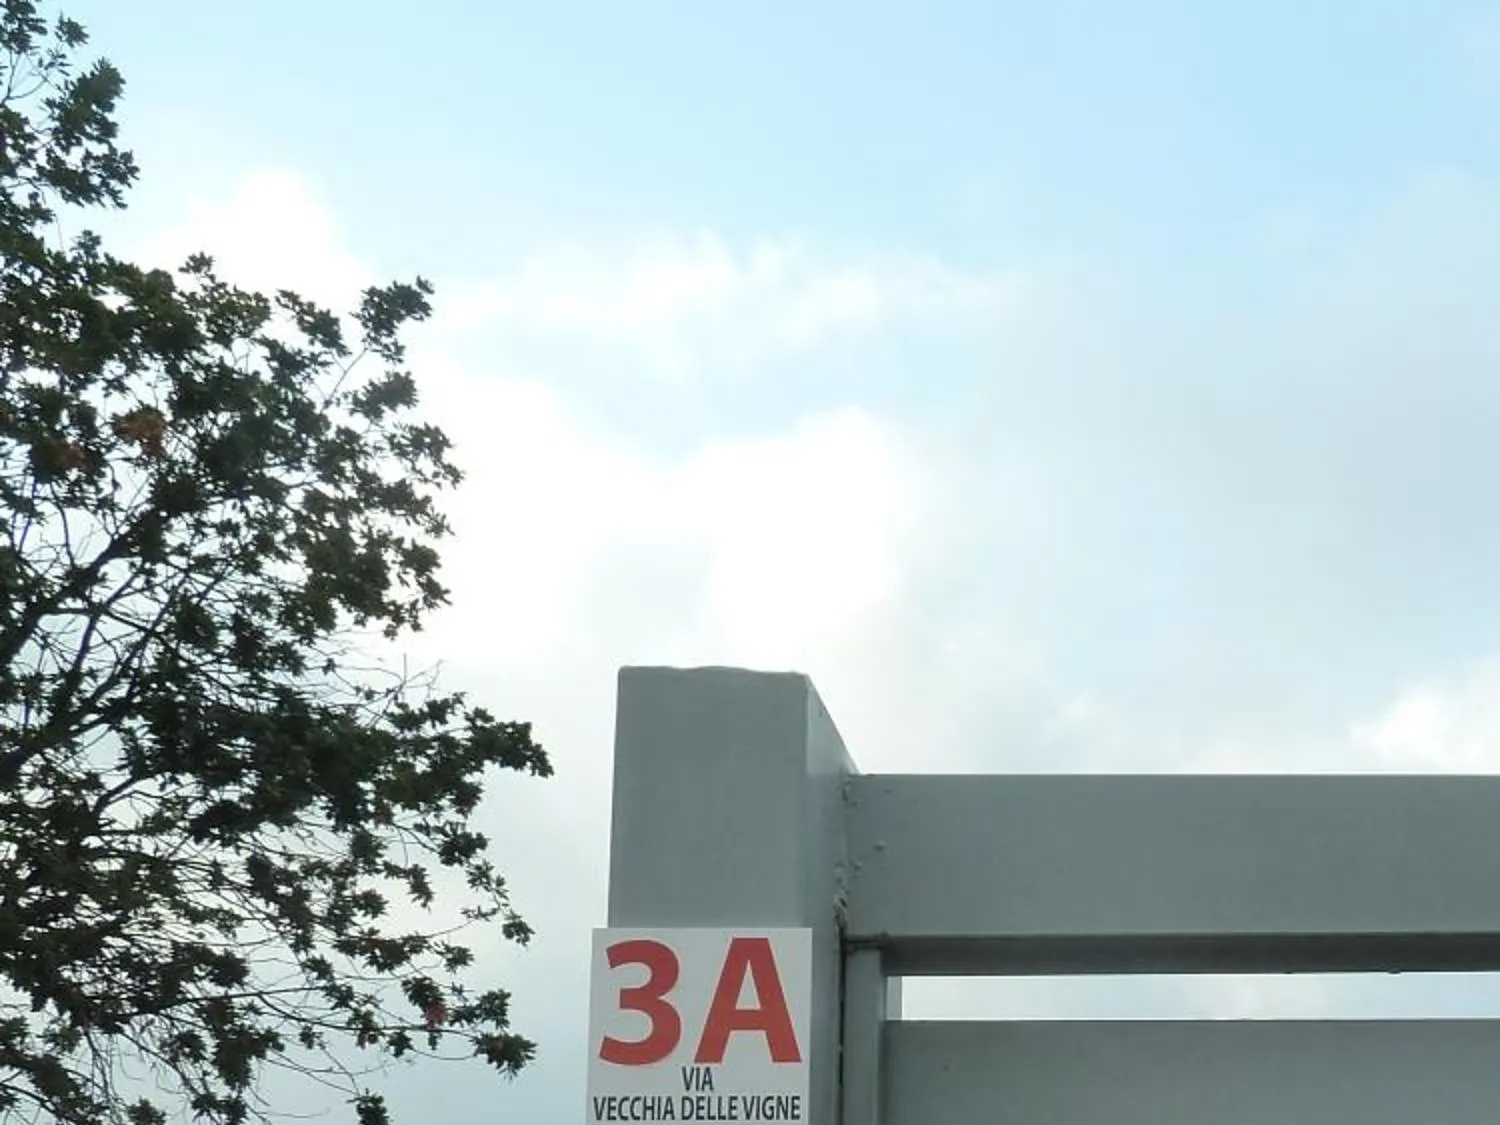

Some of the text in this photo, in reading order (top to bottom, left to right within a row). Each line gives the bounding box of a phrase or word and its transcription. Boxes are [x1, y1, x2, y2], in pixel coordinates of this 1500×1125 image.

[598, 938, 802, 1066] 3A
[681, 1066, 714, 1092] VIA
[593, 1096, 801, 1121] VECCHIA DELLE VIGNE
